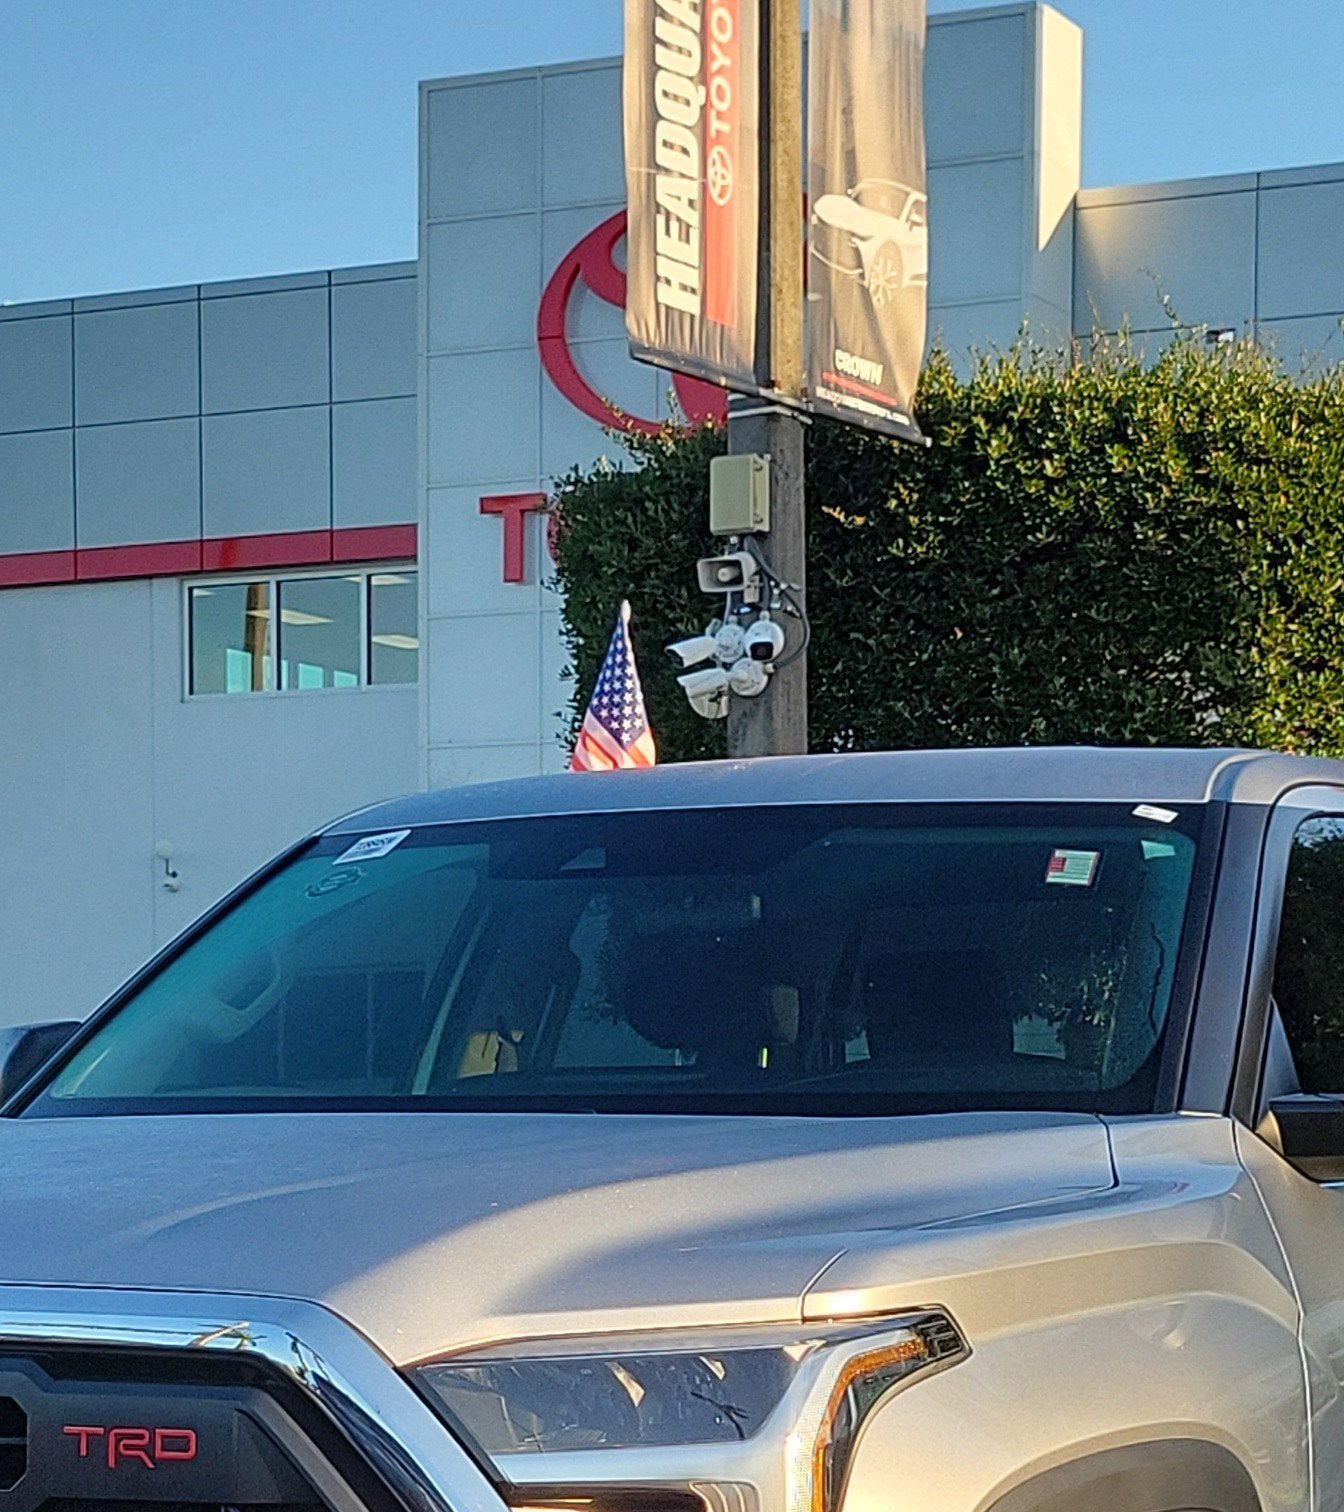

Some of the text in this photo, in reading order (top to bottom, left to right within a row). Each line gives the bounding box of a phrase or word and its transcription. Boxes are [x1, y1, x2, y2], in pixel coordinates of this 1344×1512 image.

[710, 0, 733, 138] TOYO
[835, 349, 883, 385] CROWN
[479, 492, 561, 583] T
[63, 1425, 197, 1469] TRD
